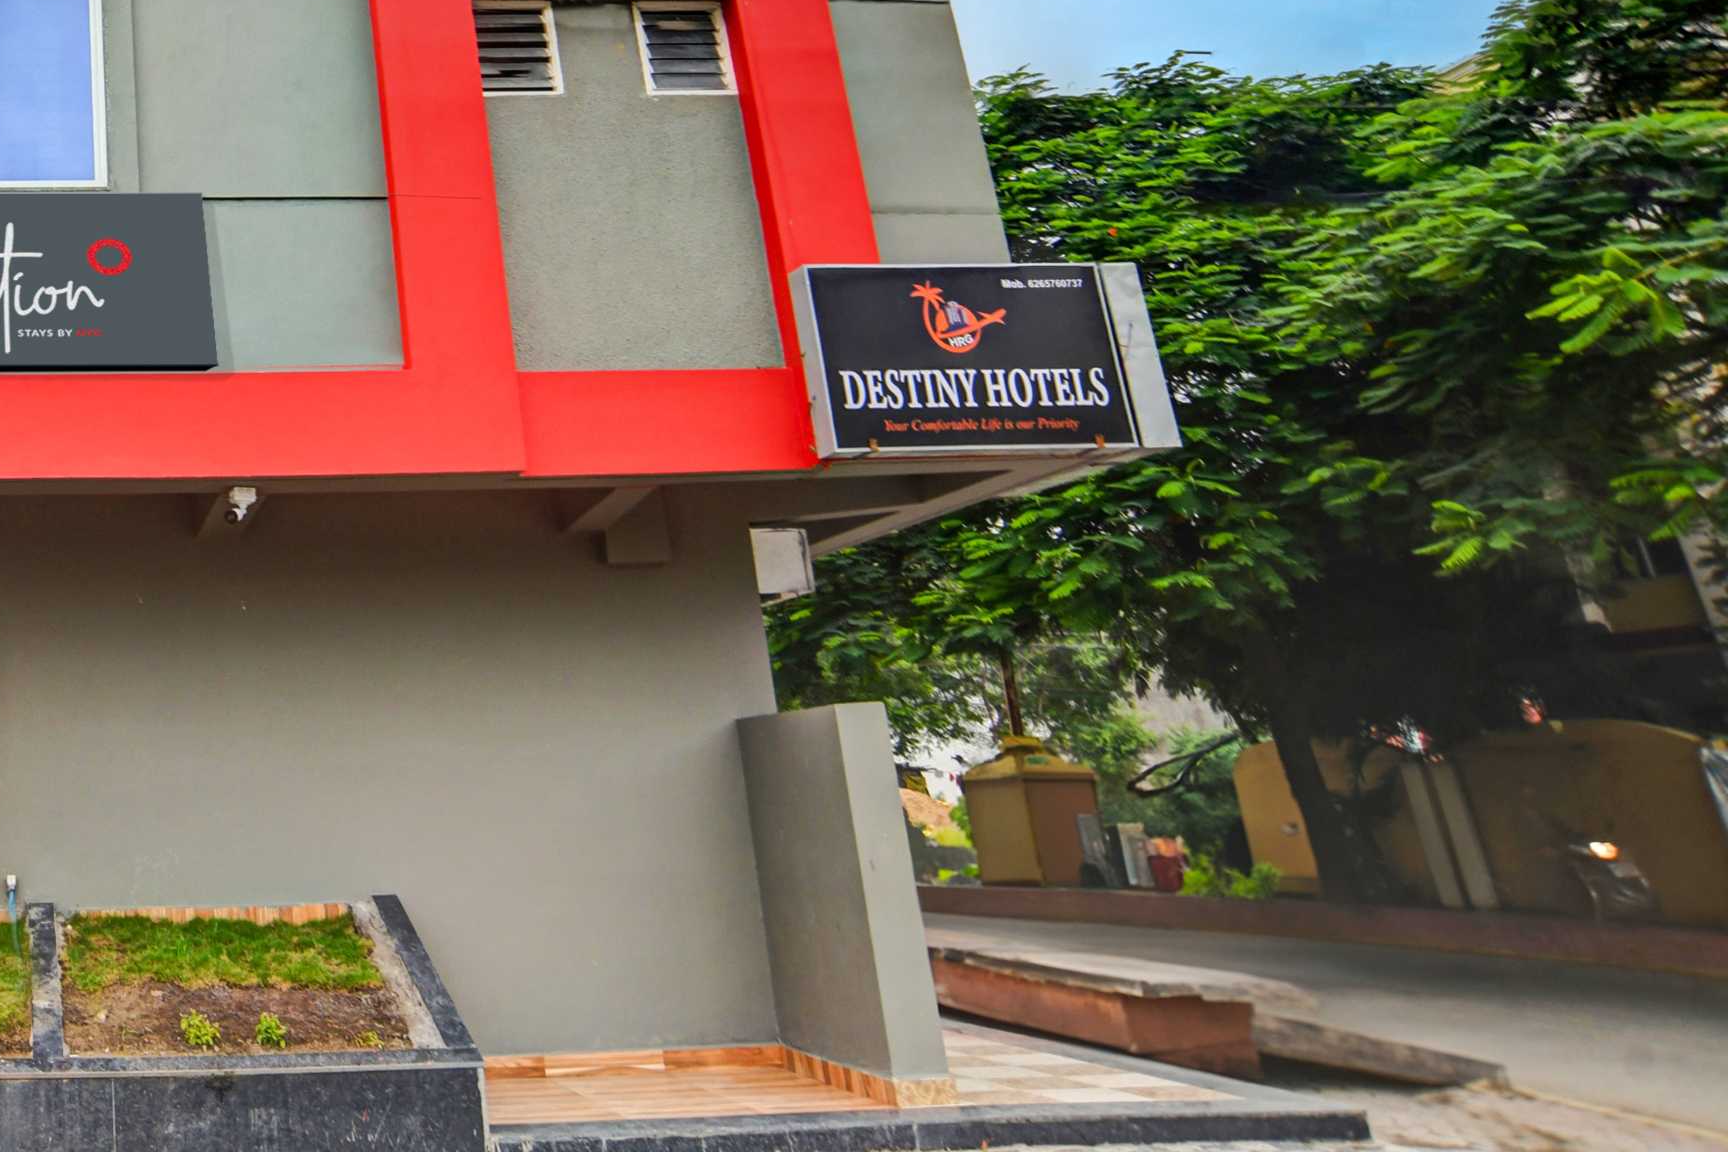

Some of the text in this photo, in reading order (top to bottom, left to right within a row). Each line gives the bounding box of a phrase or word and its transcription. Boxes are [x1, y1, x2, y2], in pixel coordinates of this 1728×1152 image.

[17, 329, 54, 338] STAYS
[57, 329, 73, 338] BY
[838, 367, 1111, 410] DESTINY HOTELS
[883, 416, 1080, 434] Your Comfortable Life is our Priority
